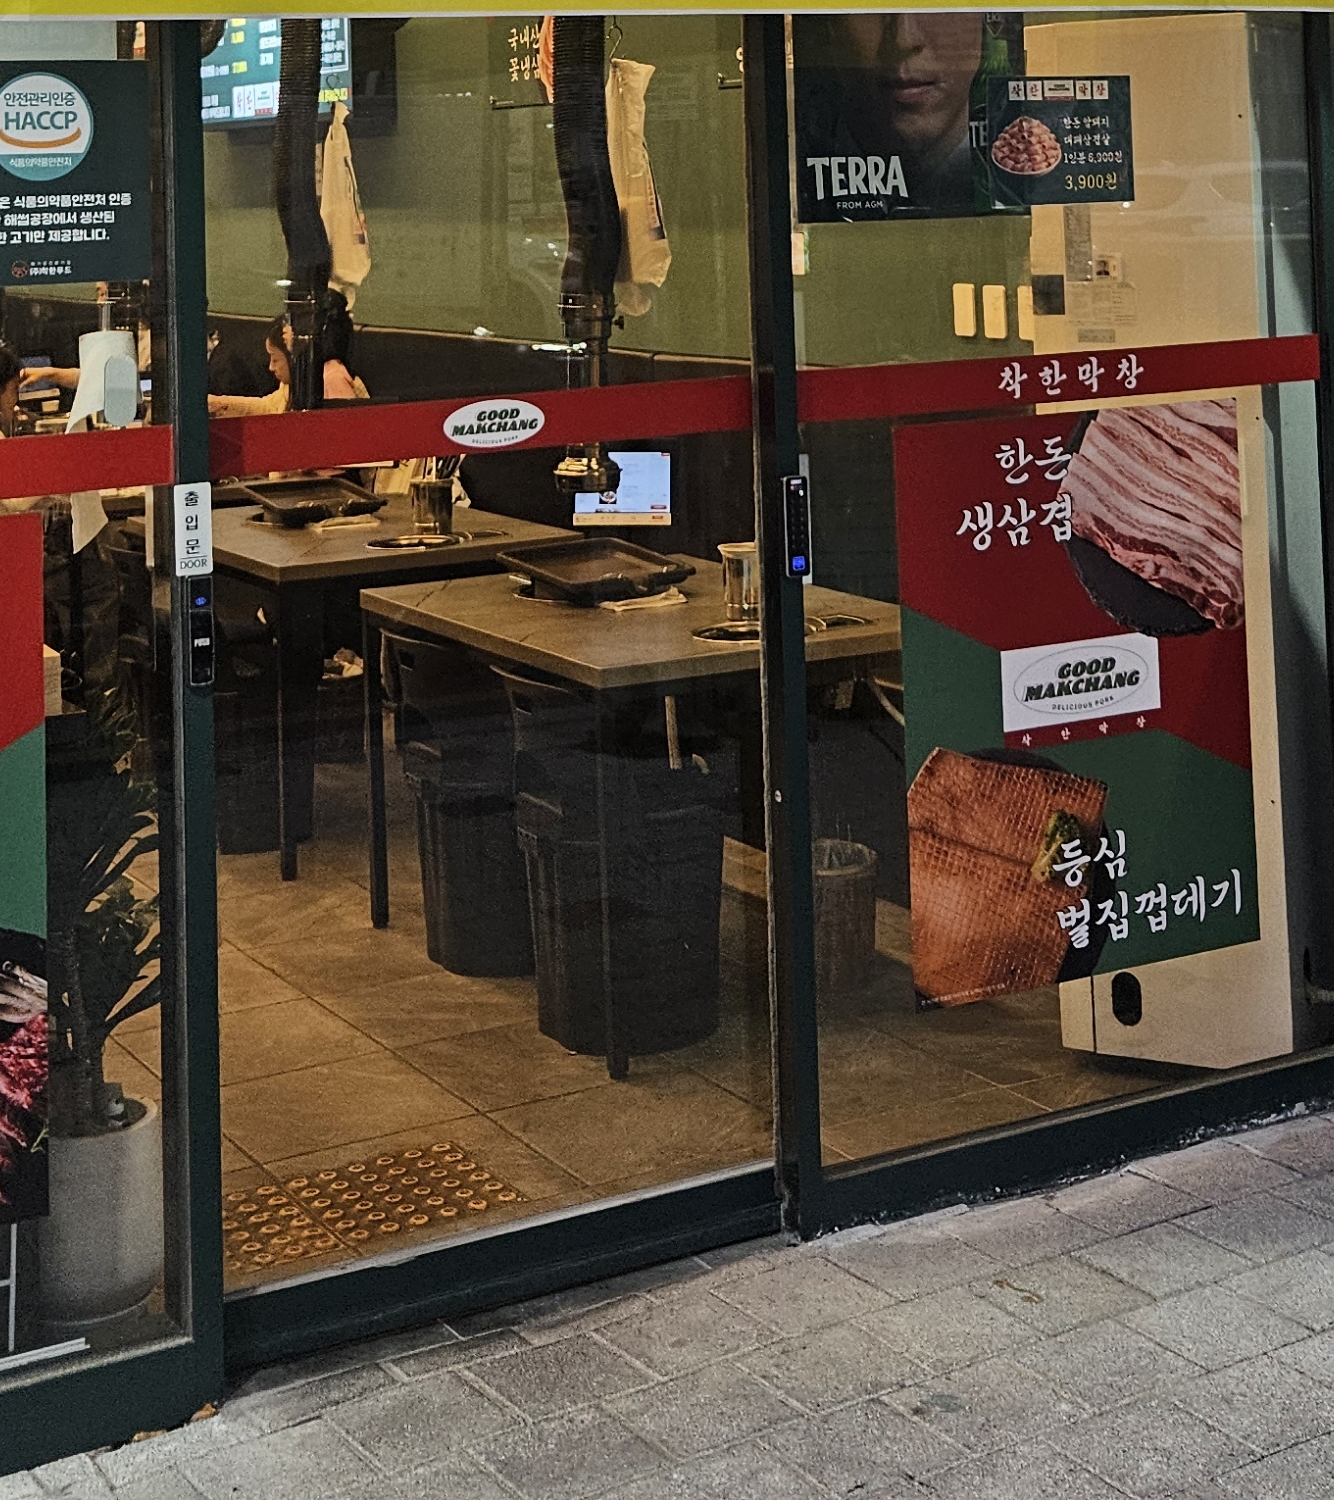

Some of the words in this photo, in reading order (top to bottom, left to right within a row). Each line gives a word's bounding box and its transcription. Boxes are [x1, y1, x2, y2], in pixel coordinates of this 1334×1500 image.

[3, 92, 77, 107] 안전관리인증
[3, 110, 78, 131] HACCP
[806, 155, 909, 201] TERRA
[1064, 171, 1117, 191] 3,900원
[13, 193, 107, 209] 식품의약품안전처
[108, 193, 133, 206] 인증
[836, 201, 862, 210] FROM
[865, 200, 884, 209] AGM
[3, 211, 78, 227] 해썹공장에서
[9, 230, 46, 245] 고기만
[47, 228, 111, 243] 제공합니다.
[476, 407, 521, 422] GOOD
[451, 418, 539, 437] MAKCHANG
[994, 434, 1075, 486] 한돈
[179, 558, 207, 570] DOOR
[1055, 656, 1117, 679] GOOD
[1023, 669, 1141, 703] MAKCHANG
[1050, 835, 1129, 889] 등심
[1056, 867, 1244, 950] 벌집껍데기
